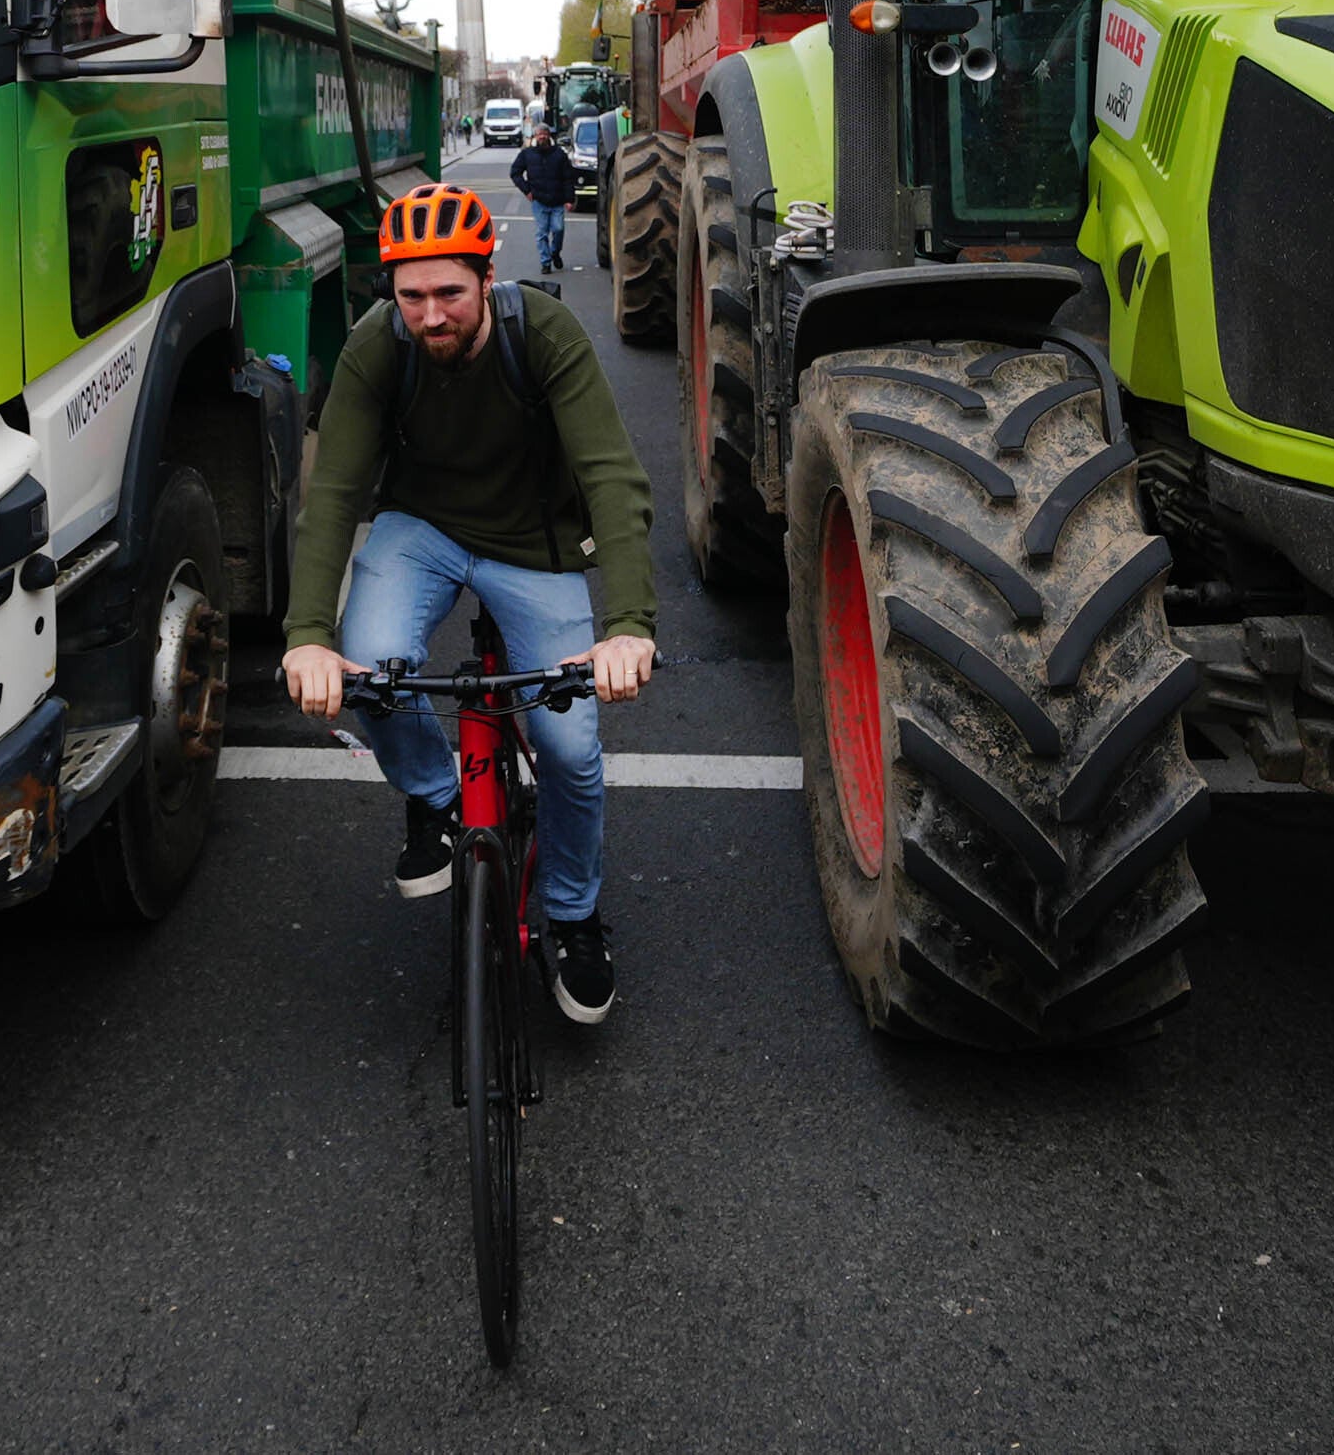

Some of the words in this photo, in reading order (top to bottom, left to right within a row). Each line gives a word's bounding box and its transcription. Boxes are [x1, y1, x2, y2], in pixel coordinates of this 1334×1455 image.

[1105, 12, 1146, 68] CLAAS
[315, 73, 370, 134] FARRY
[1106, 92, 1127, 122] AXION
